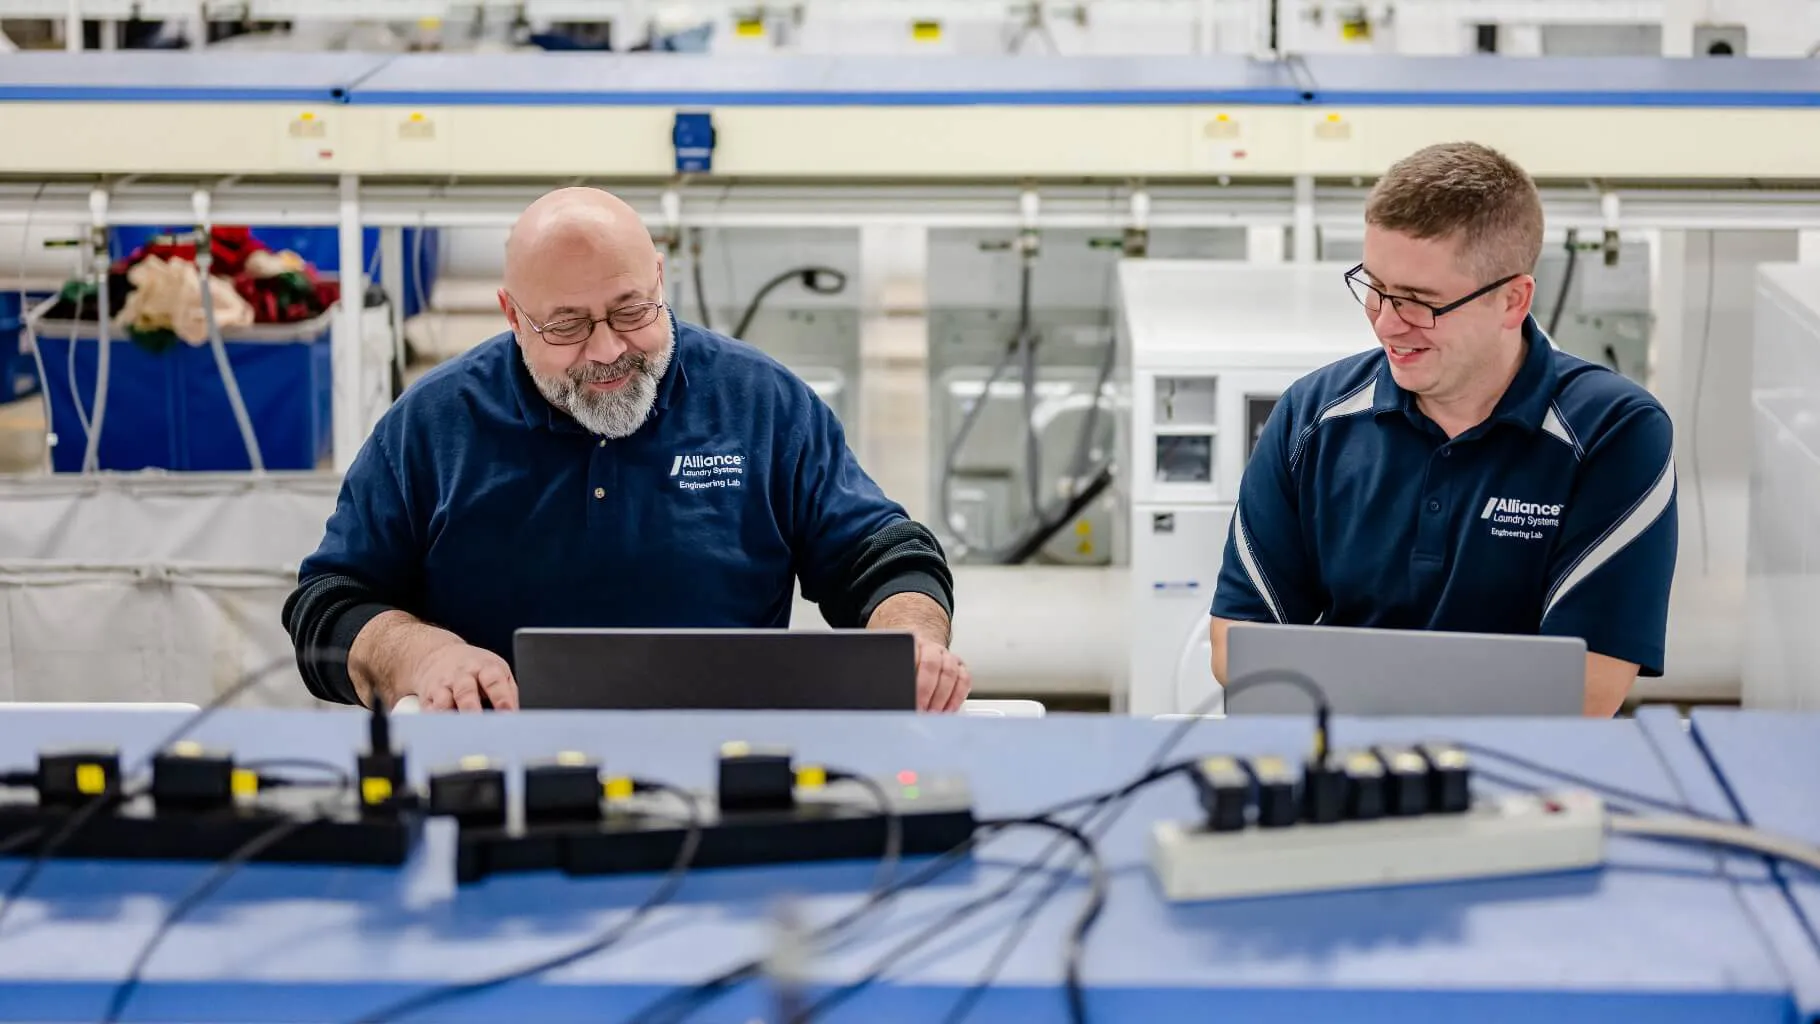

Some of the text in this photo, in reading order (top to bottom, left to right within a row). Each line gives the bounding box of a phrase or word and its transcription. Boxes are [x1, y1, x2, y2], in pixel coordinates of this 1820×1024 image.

[682, 455, 742, 468] Alliance
[682, 466, 743, 476] Laundry Systems
[679, 479, 741, 490] Engineering Lab
[1496, 497, 1560, 516] Alliance
[1493, 513, 1560, 527] Laundry Systems
[1491, 527, 1543, 539] Engineering Lab
